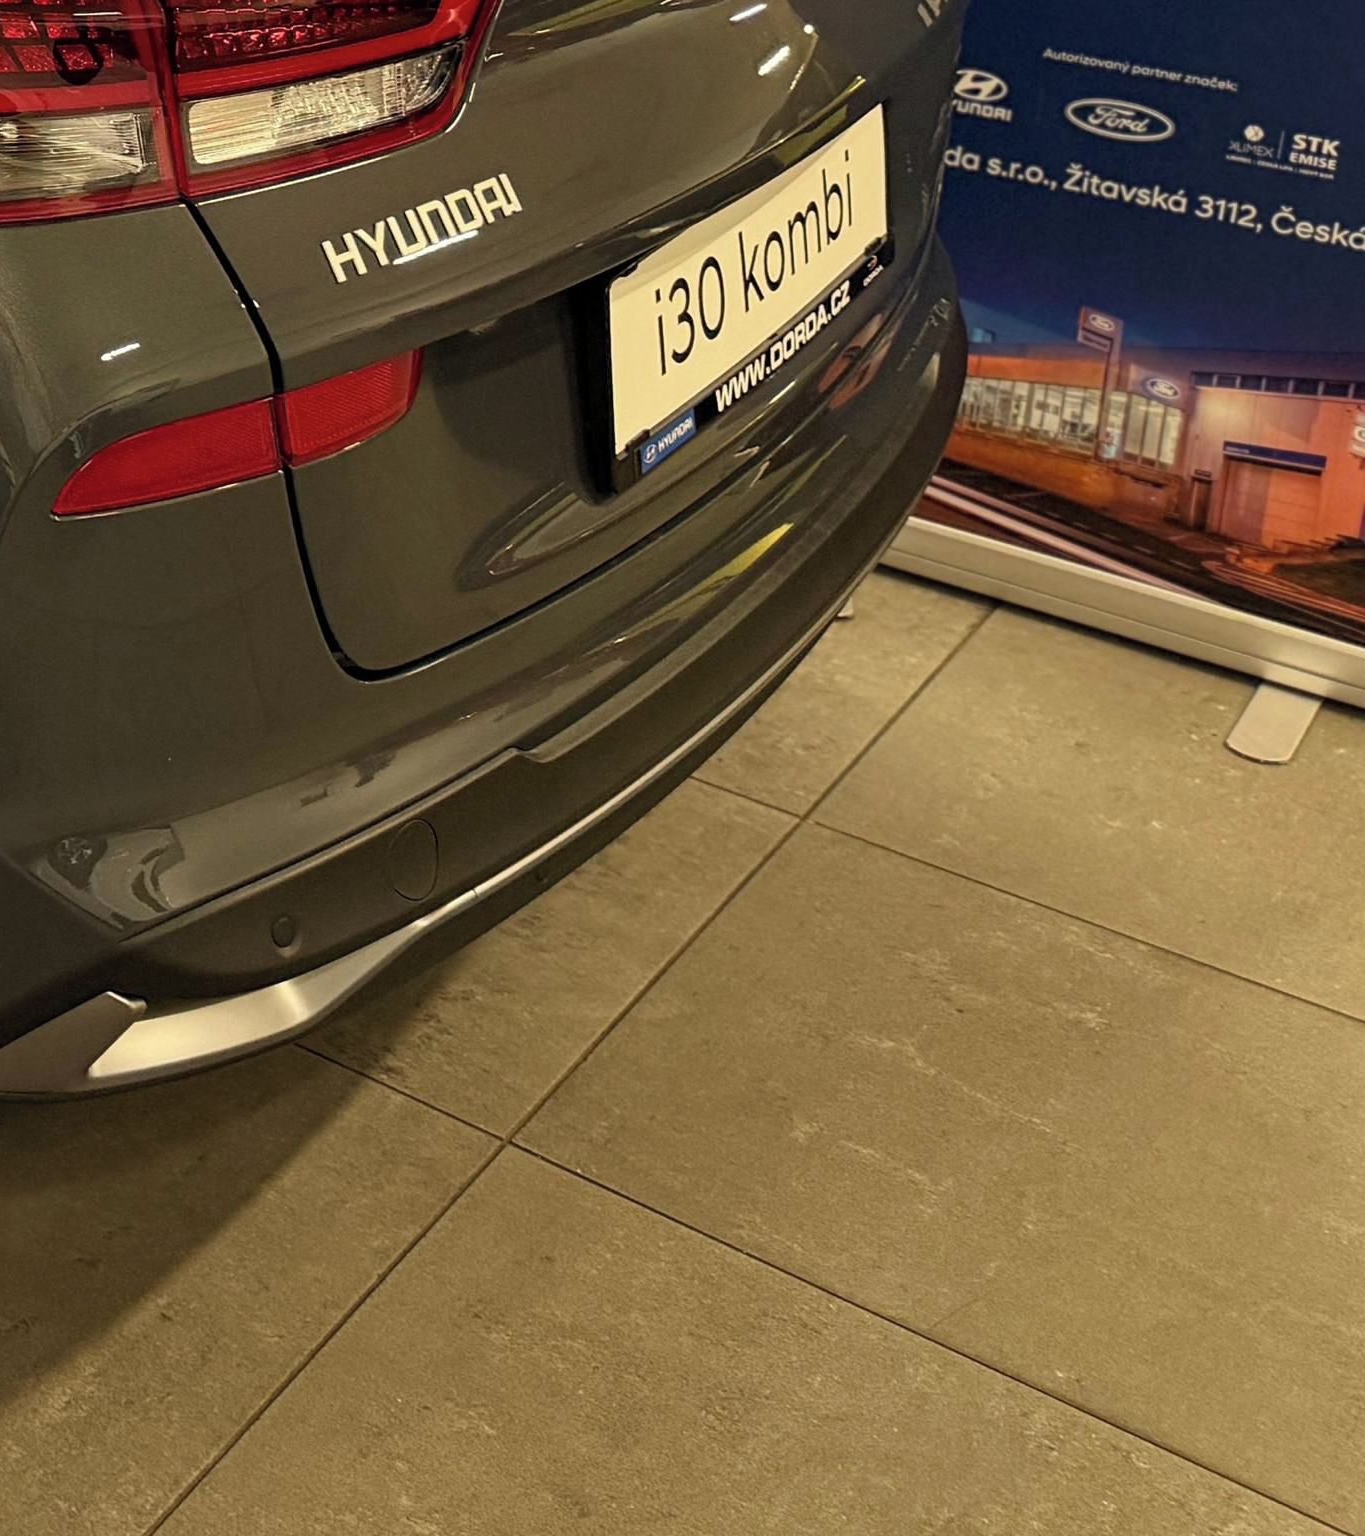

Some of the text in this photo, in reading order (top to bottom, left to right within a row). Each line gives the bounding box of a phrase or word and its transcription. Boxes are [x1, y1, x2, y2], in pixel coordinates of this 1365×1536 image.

[1043, 47, 1130, 73] Autorizovaný
[1131, 65, 1183, 82] partner
[1087, 105, 1149, 133] Ford
[1289, 152, 1337, 171] EMISE
[1292, 133, 1340, 157] STK
[986, 157, 1058, 191] s.r.o.,
[1062, 162, 1188, 213] Žitavská
[1194, 195, 1263, 233] 3112,
[1271, 205, 1365, 251] Česká
[322, 173, 523, 283] HYUNDAI
[655, 150, 854, 375] i30 kombi
[715, 280, 851, 412] WWW.DORDA.CZ
[657, 416, 694, 452] HYUNDAI
